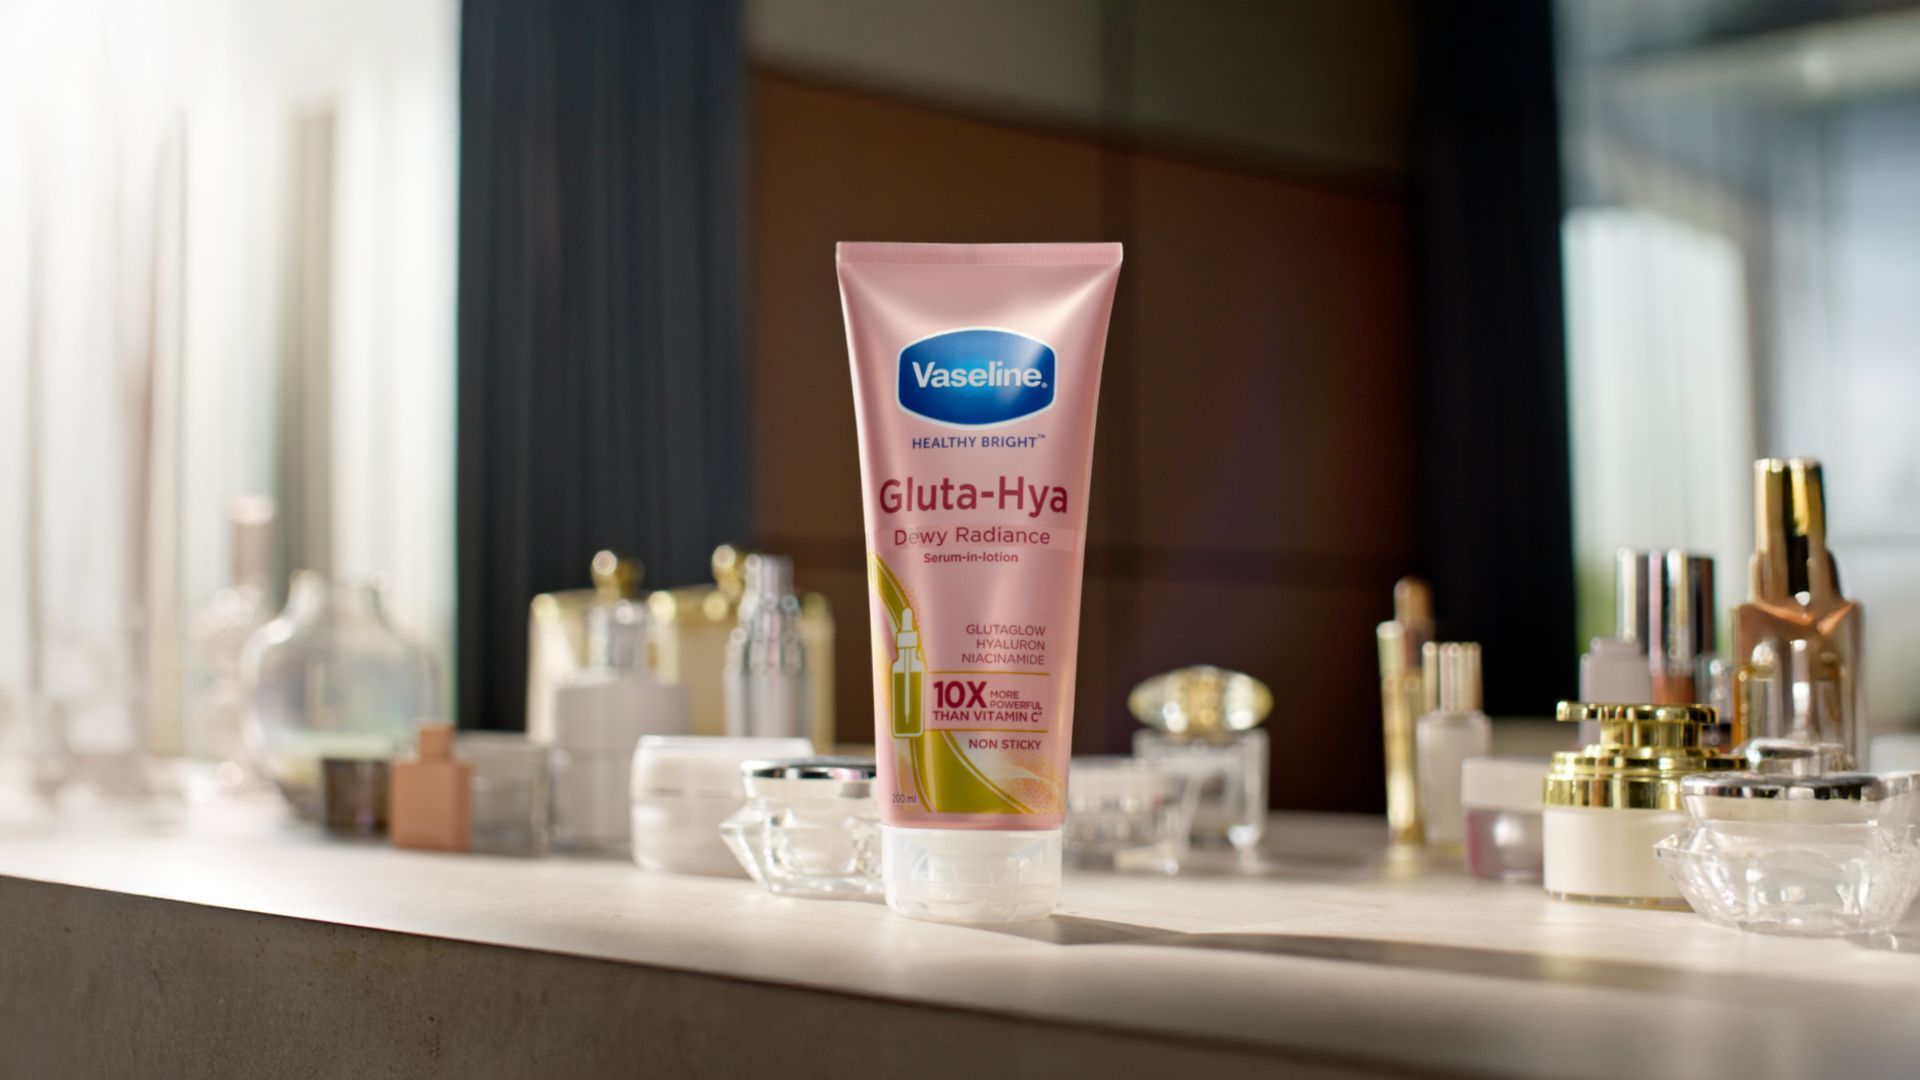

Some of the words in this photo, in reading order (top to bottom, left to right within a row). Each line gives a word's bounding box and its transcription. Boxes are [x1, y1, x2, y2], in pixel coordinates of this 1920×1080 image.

[912, 436, 977, 449] HEALTHY
[879, 476, 1068, 518] Gluta-Hya
[895, 529, 948, 546] Dewy
[956, 526, 1050, 545] Radiance
[923, 551, 1018, 563] Serum-in-lotion
[966, 624, 1046, 636] GLUTAGLOW
[976, 639, 1046, 651] HYALURON
[961, 653, 1045, 665] NIACINAMIDE
[933, 680, 988, 709] 10X
[990, 690, 1019, 699] MORE
[990, 700, 1042, 710] POWERFUL
[932, 711, 970, 721] THAN
[974, 711, 1028, 722] VITAMIN
[968, 738, 998, 750] NON
[1001, 739, 1042, 751] STICKY
[892, 793, 905, 804] 200
[906, 793, 917, 804] ml
